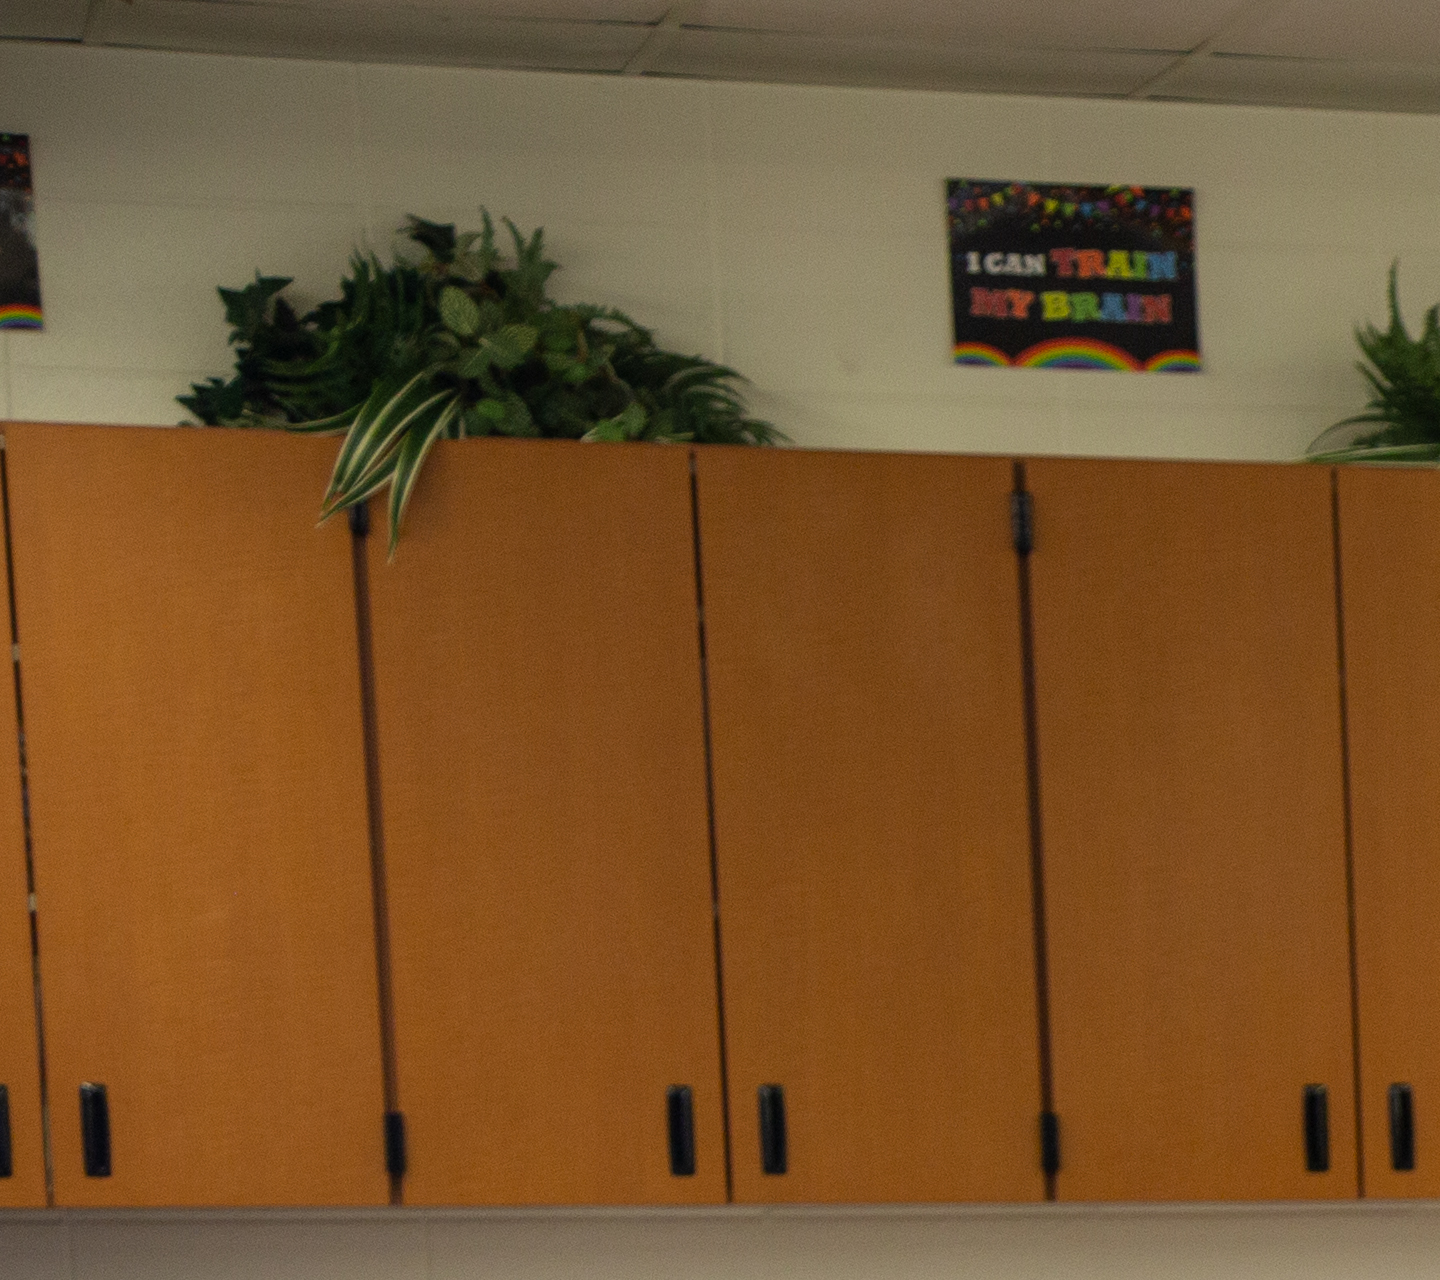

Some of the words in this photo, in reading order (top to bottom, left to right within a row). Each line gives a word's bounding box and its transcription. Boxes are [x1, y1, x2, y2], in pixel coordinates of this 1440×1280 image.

[966, 252, 981, 274] I
[983, 254, 1046, 276] CAN
[1050, 249, 1176, 280] TRAIN
[970, 288, 1035, 320] MY
[1042, 291, 1172, 323] BRAIN
